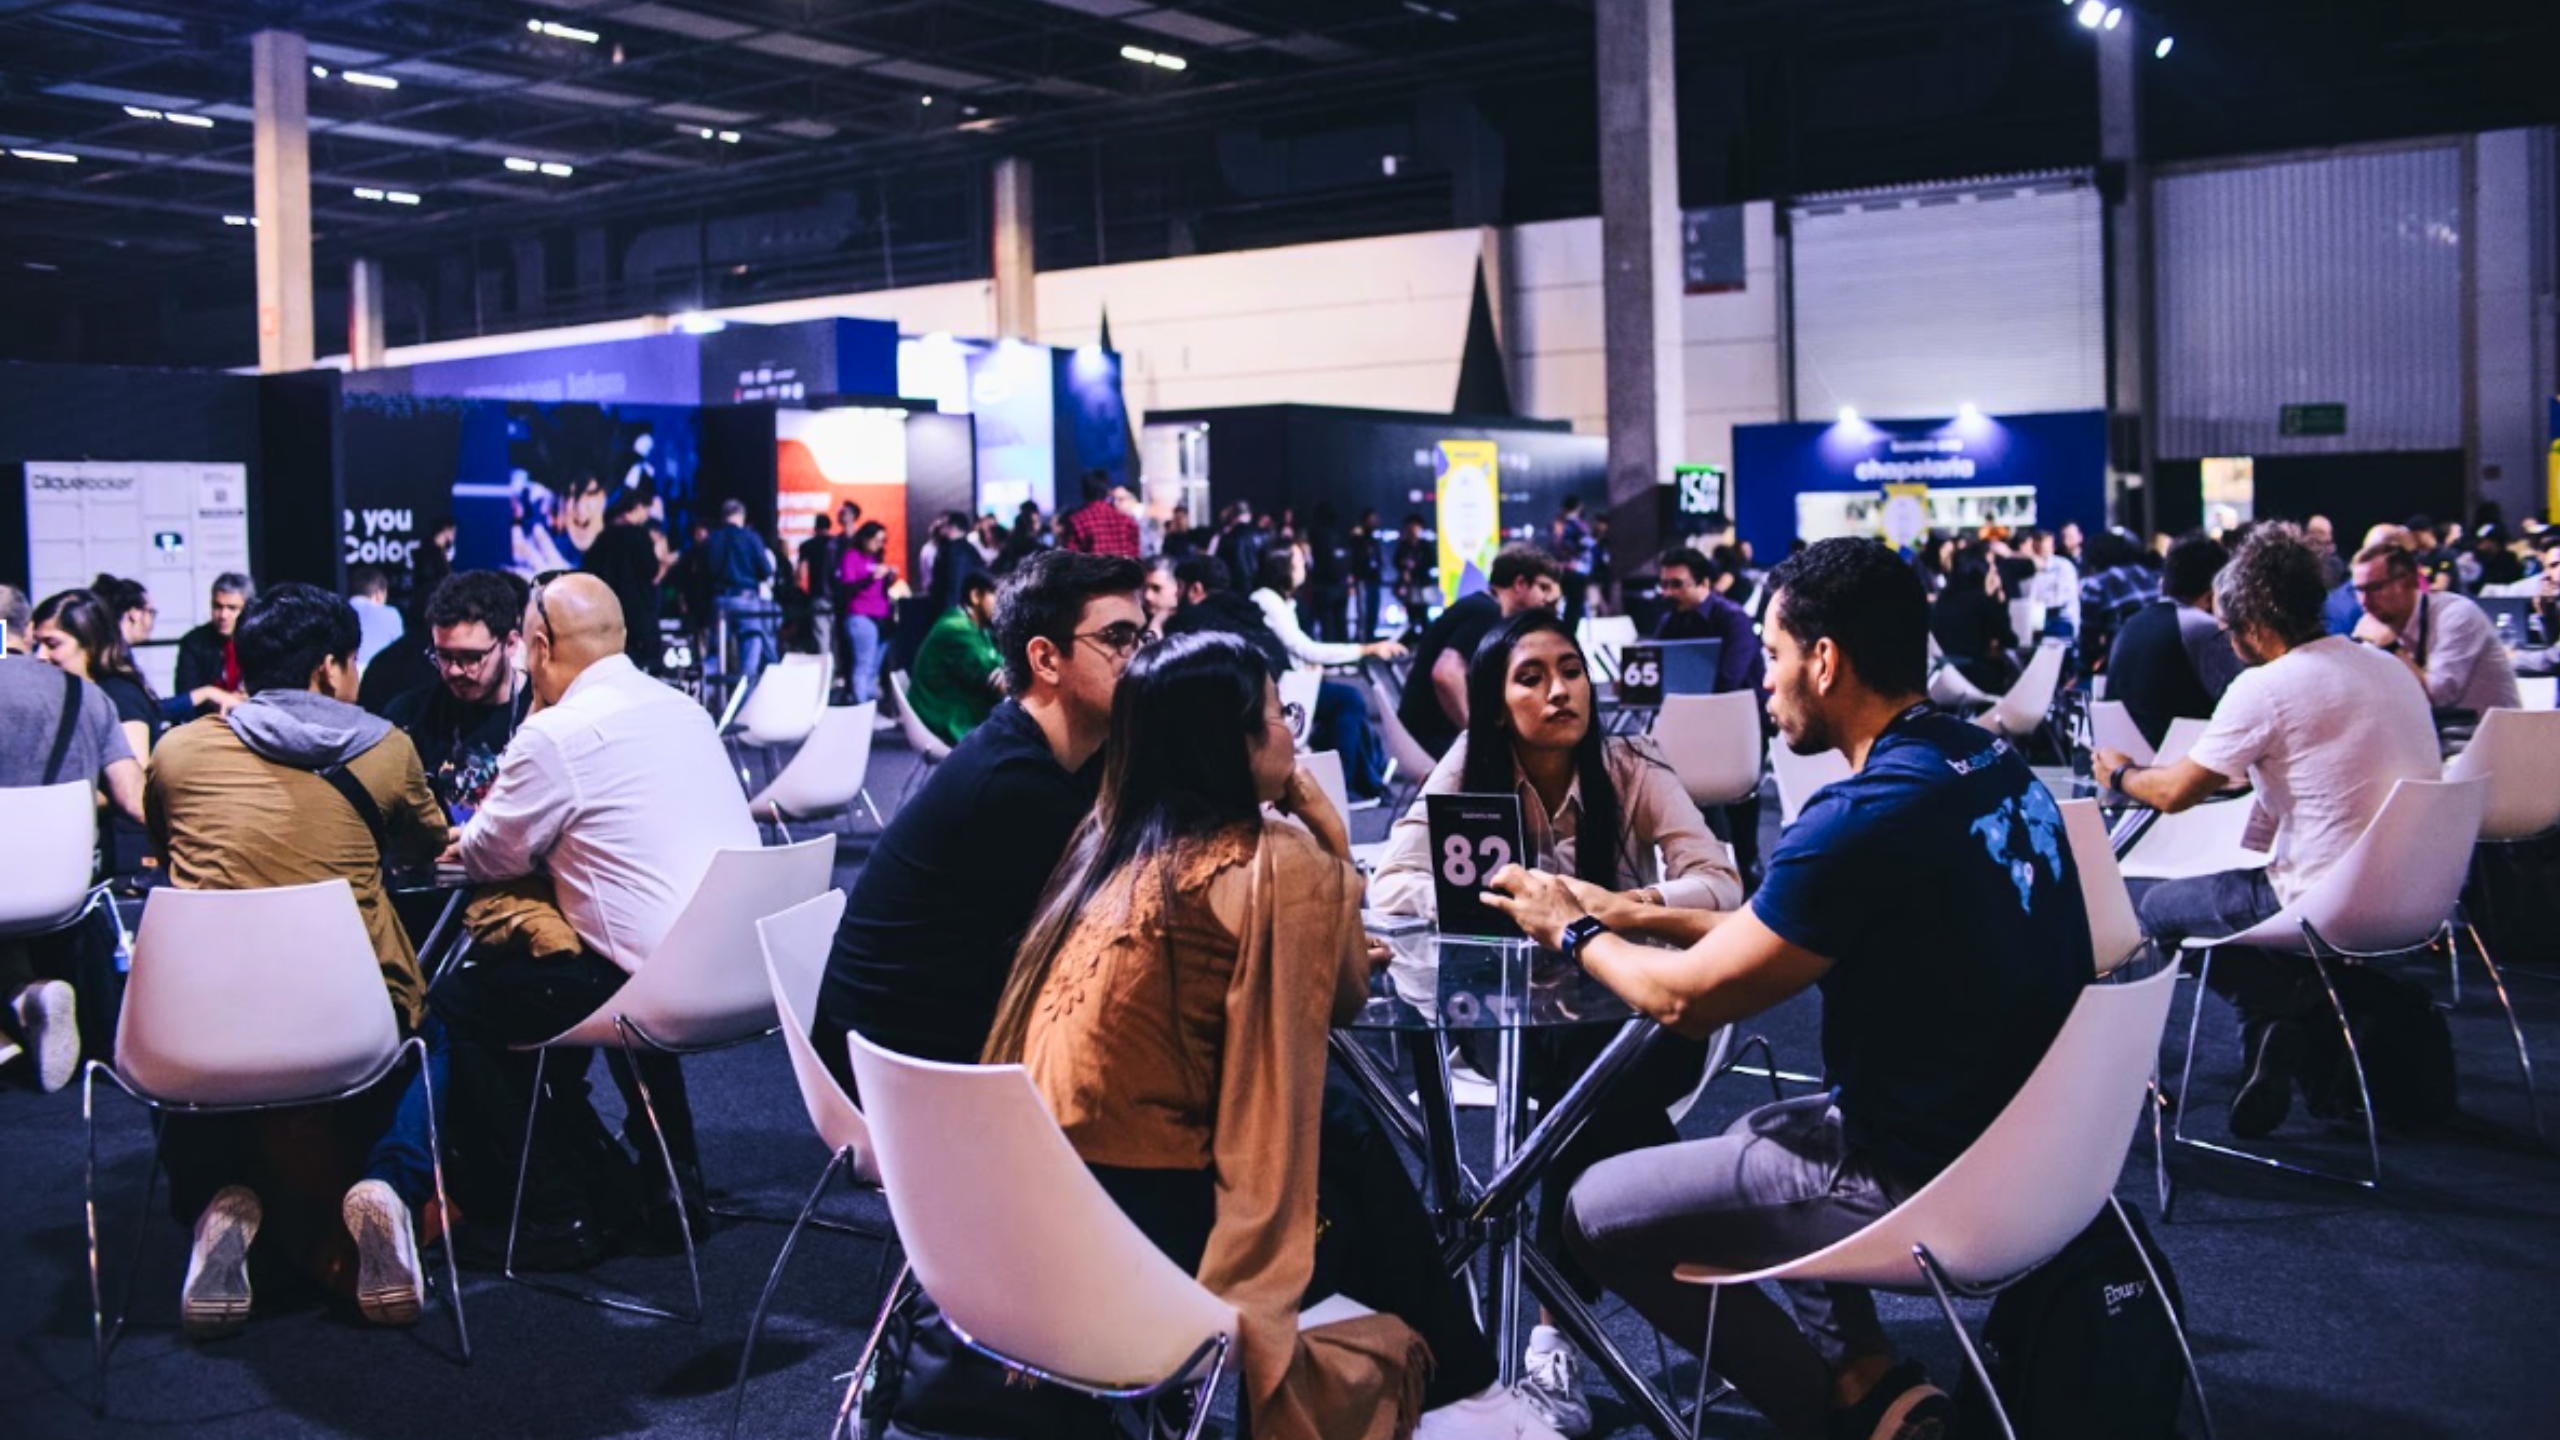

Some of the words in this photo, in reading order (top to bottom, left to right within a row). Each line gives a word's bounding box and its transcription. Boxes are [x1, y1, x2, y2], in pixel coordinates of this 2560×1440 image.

[362, 509, 412, 537] you
[1624, 662, 1659, 687] 65
[1443, 834, 1511, 887] 82
